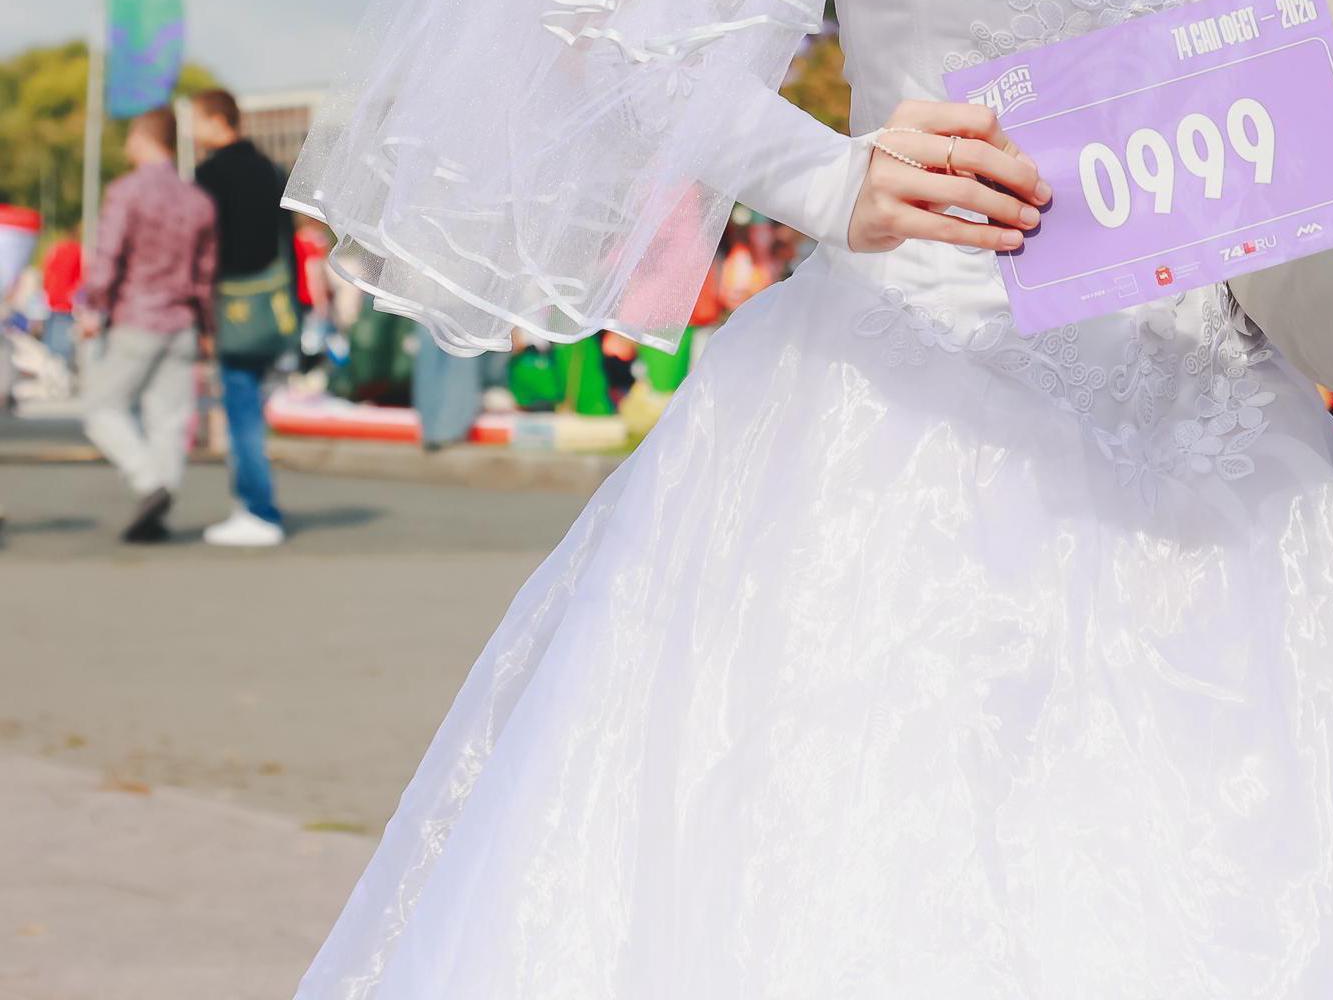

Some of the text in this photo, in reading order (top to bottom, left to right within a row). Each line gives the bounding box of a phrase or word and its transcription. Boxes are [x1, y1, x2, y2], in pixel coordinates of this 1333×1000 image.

[1170, 26, 1193, 61] 74
[1189, 18, 1223, 55] САП
[1218, 6, 1260, 46] ФЕСТ
[1000, 68, 1031, 90] САП
[1078, 98, 1275, 228] 0999
